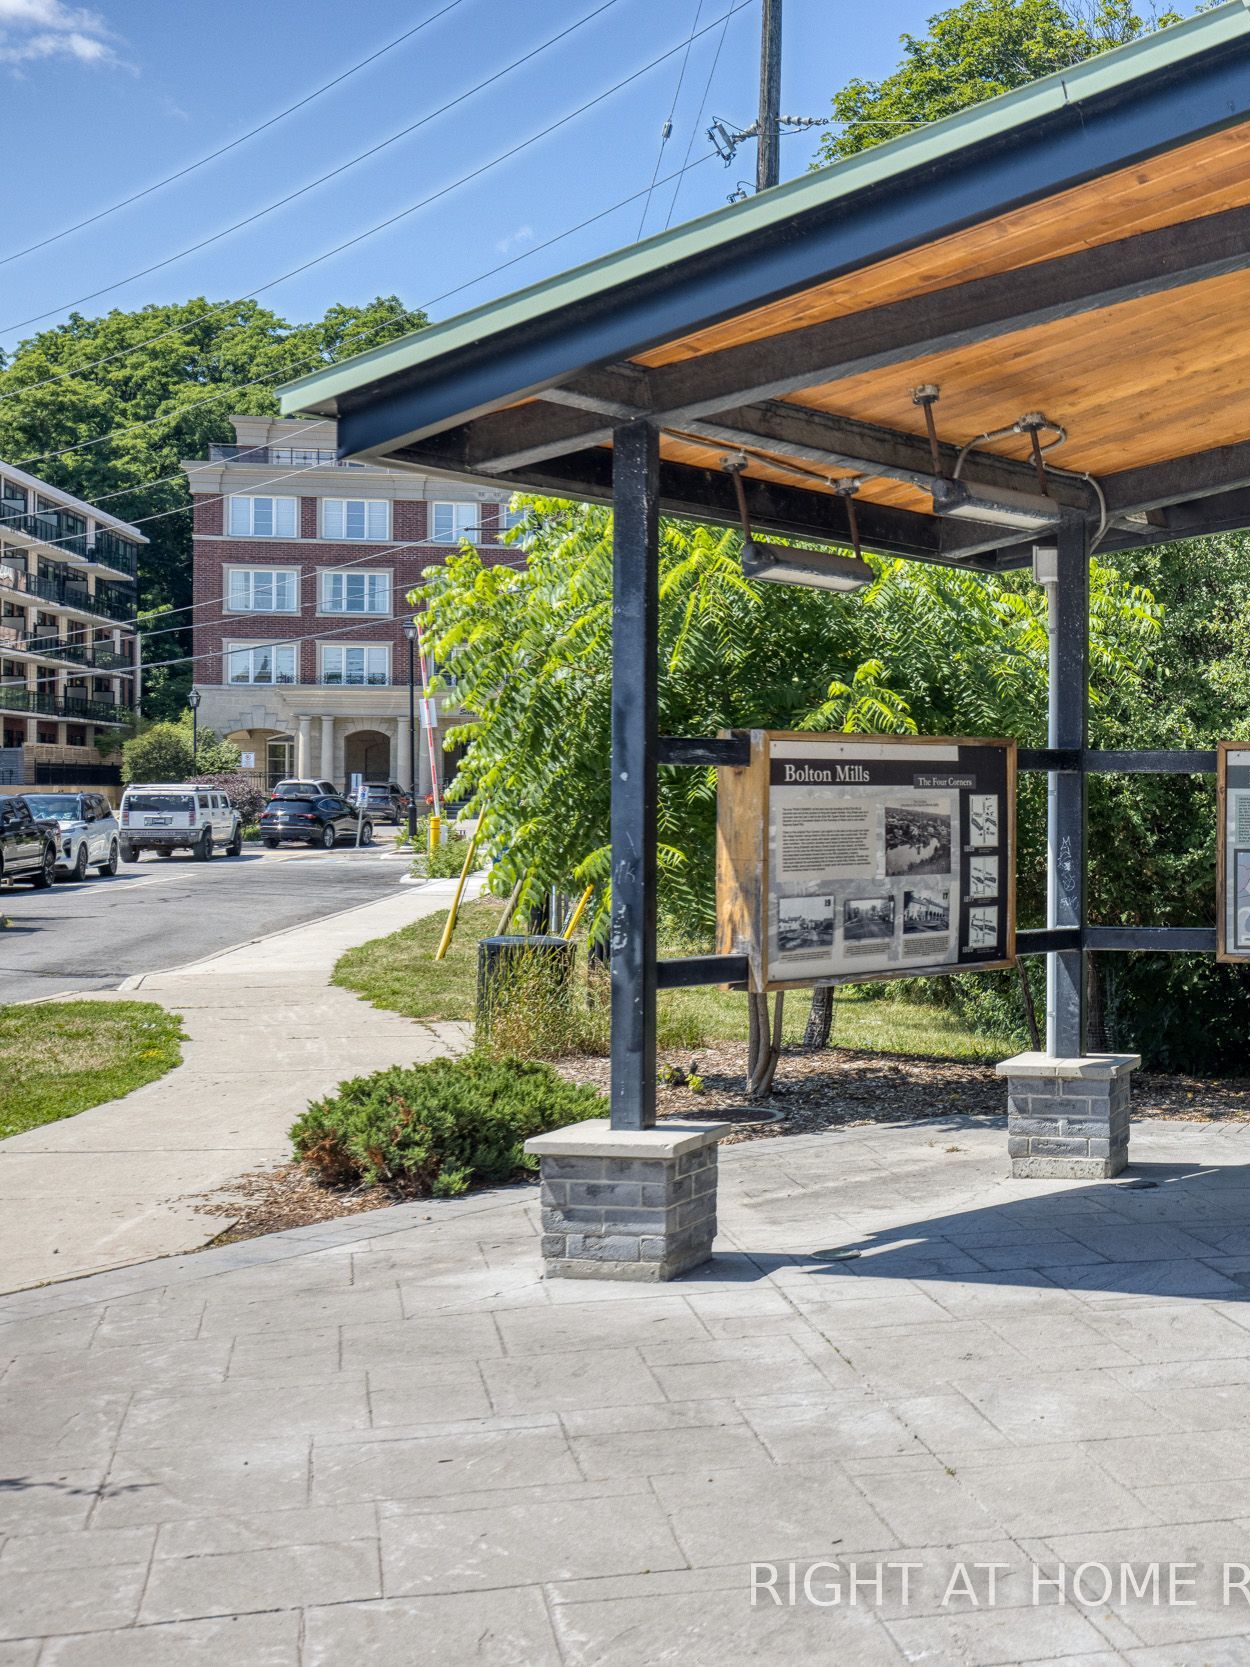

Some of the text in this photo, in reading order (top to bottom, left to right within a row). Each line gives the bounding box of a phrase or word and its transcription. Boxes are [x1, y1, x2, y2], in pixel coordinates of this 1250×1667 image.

[783, 764, 870, 782] Bolton Mills
[918, 777, 972, 787] The Four Corners
